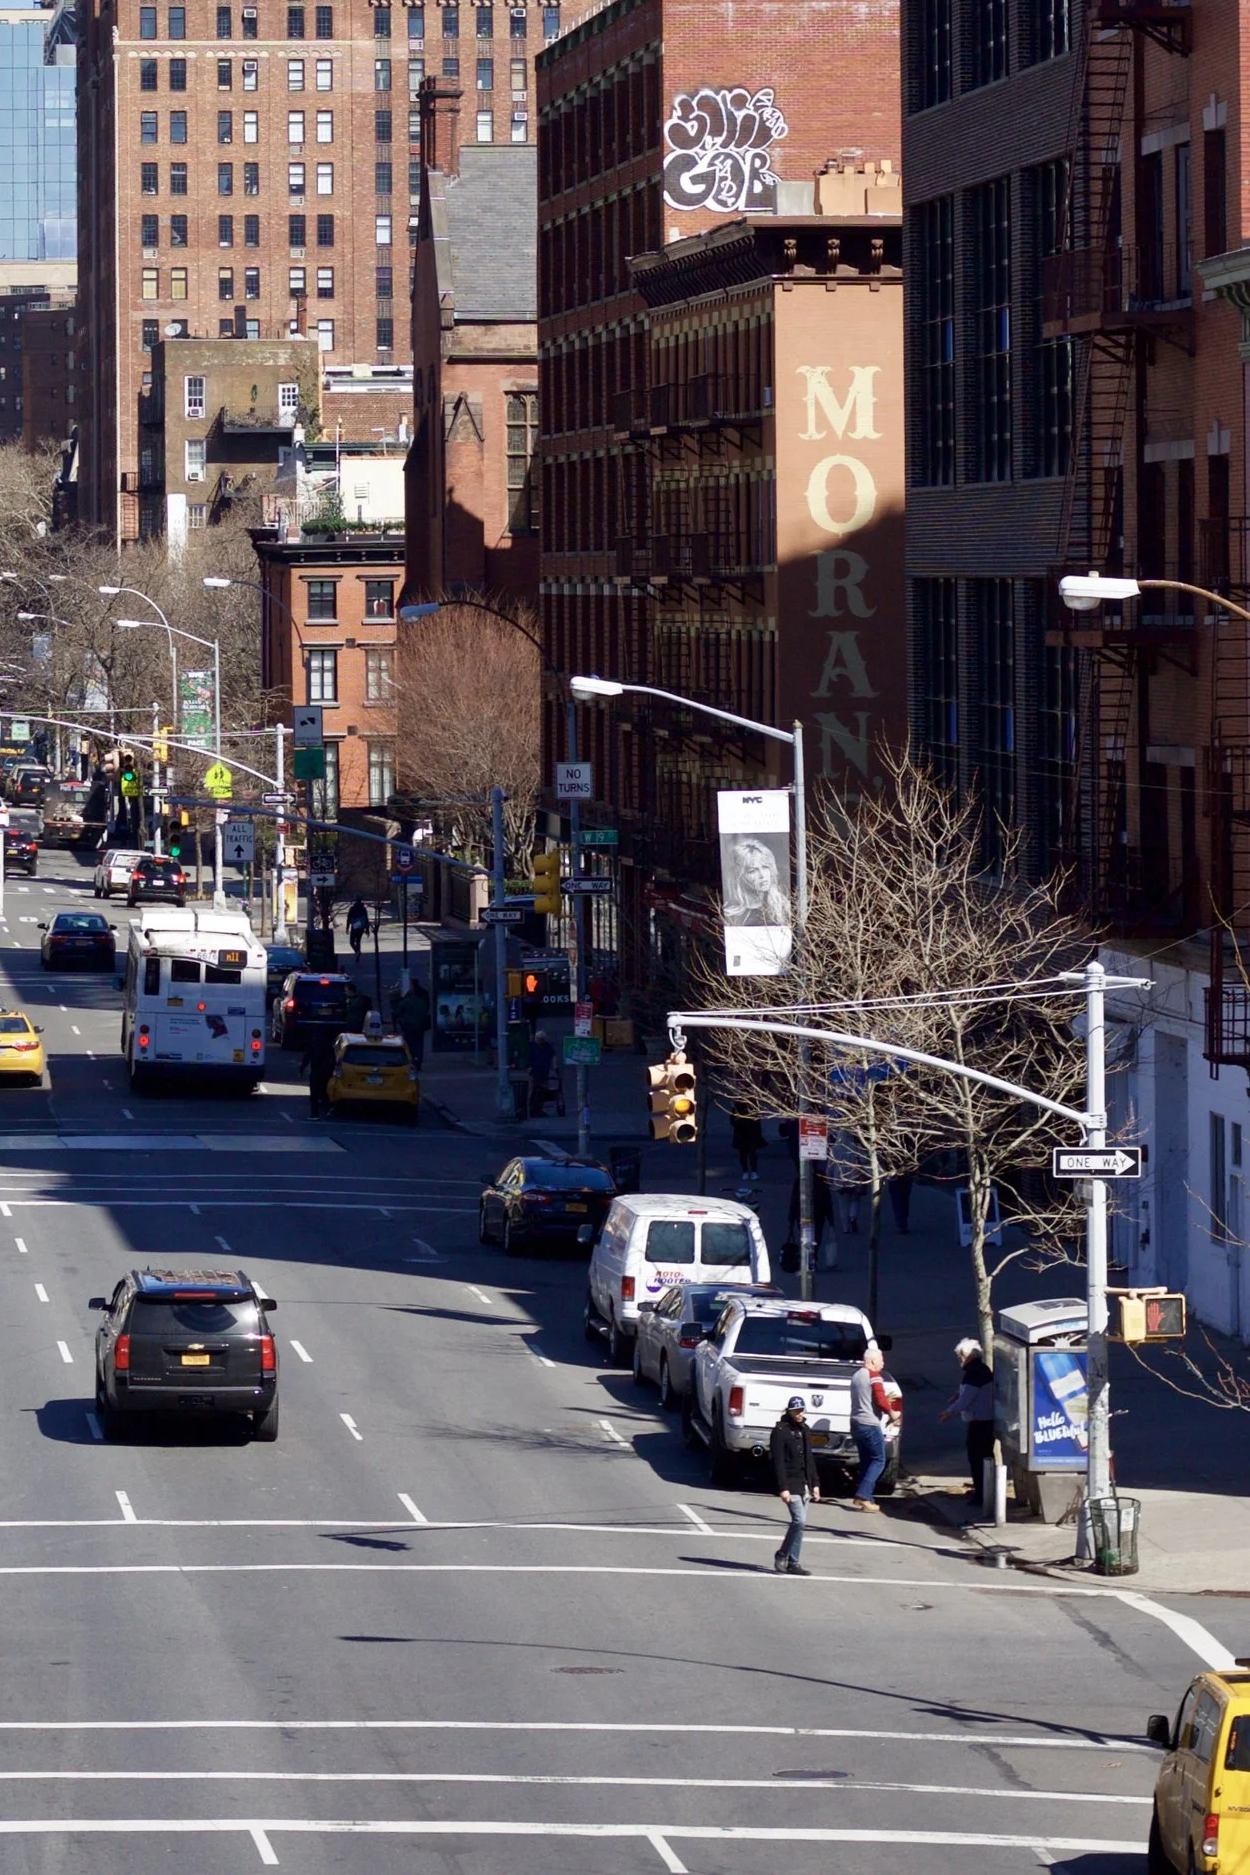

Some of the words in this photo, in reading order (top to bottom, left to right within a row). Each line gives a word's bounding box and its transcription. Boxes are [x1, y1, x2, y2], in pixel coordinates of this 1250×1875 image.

[565, 769, 581, 779] NO
[558, 783, 590, 793] TURNS
[742, 796, 763, 804] NYC
[231, 825, 247, 833] ALL
[225, 835, 253, 843] TRAFFIC
[584, 833, 592, 841] W
[595, 832, 605, 841] 19
[565, 881, 582, 889] ONE
[591, 881, 609, 889] WAY
[485, 911, 500, 919] ONE
[502, 911, 518, 919] WAY
[1067, 1157, 1091, 1168] ONE
[1102, 1157, 1127, 1168] WAY
[1037, 1411, 1065, 1430] Hello
